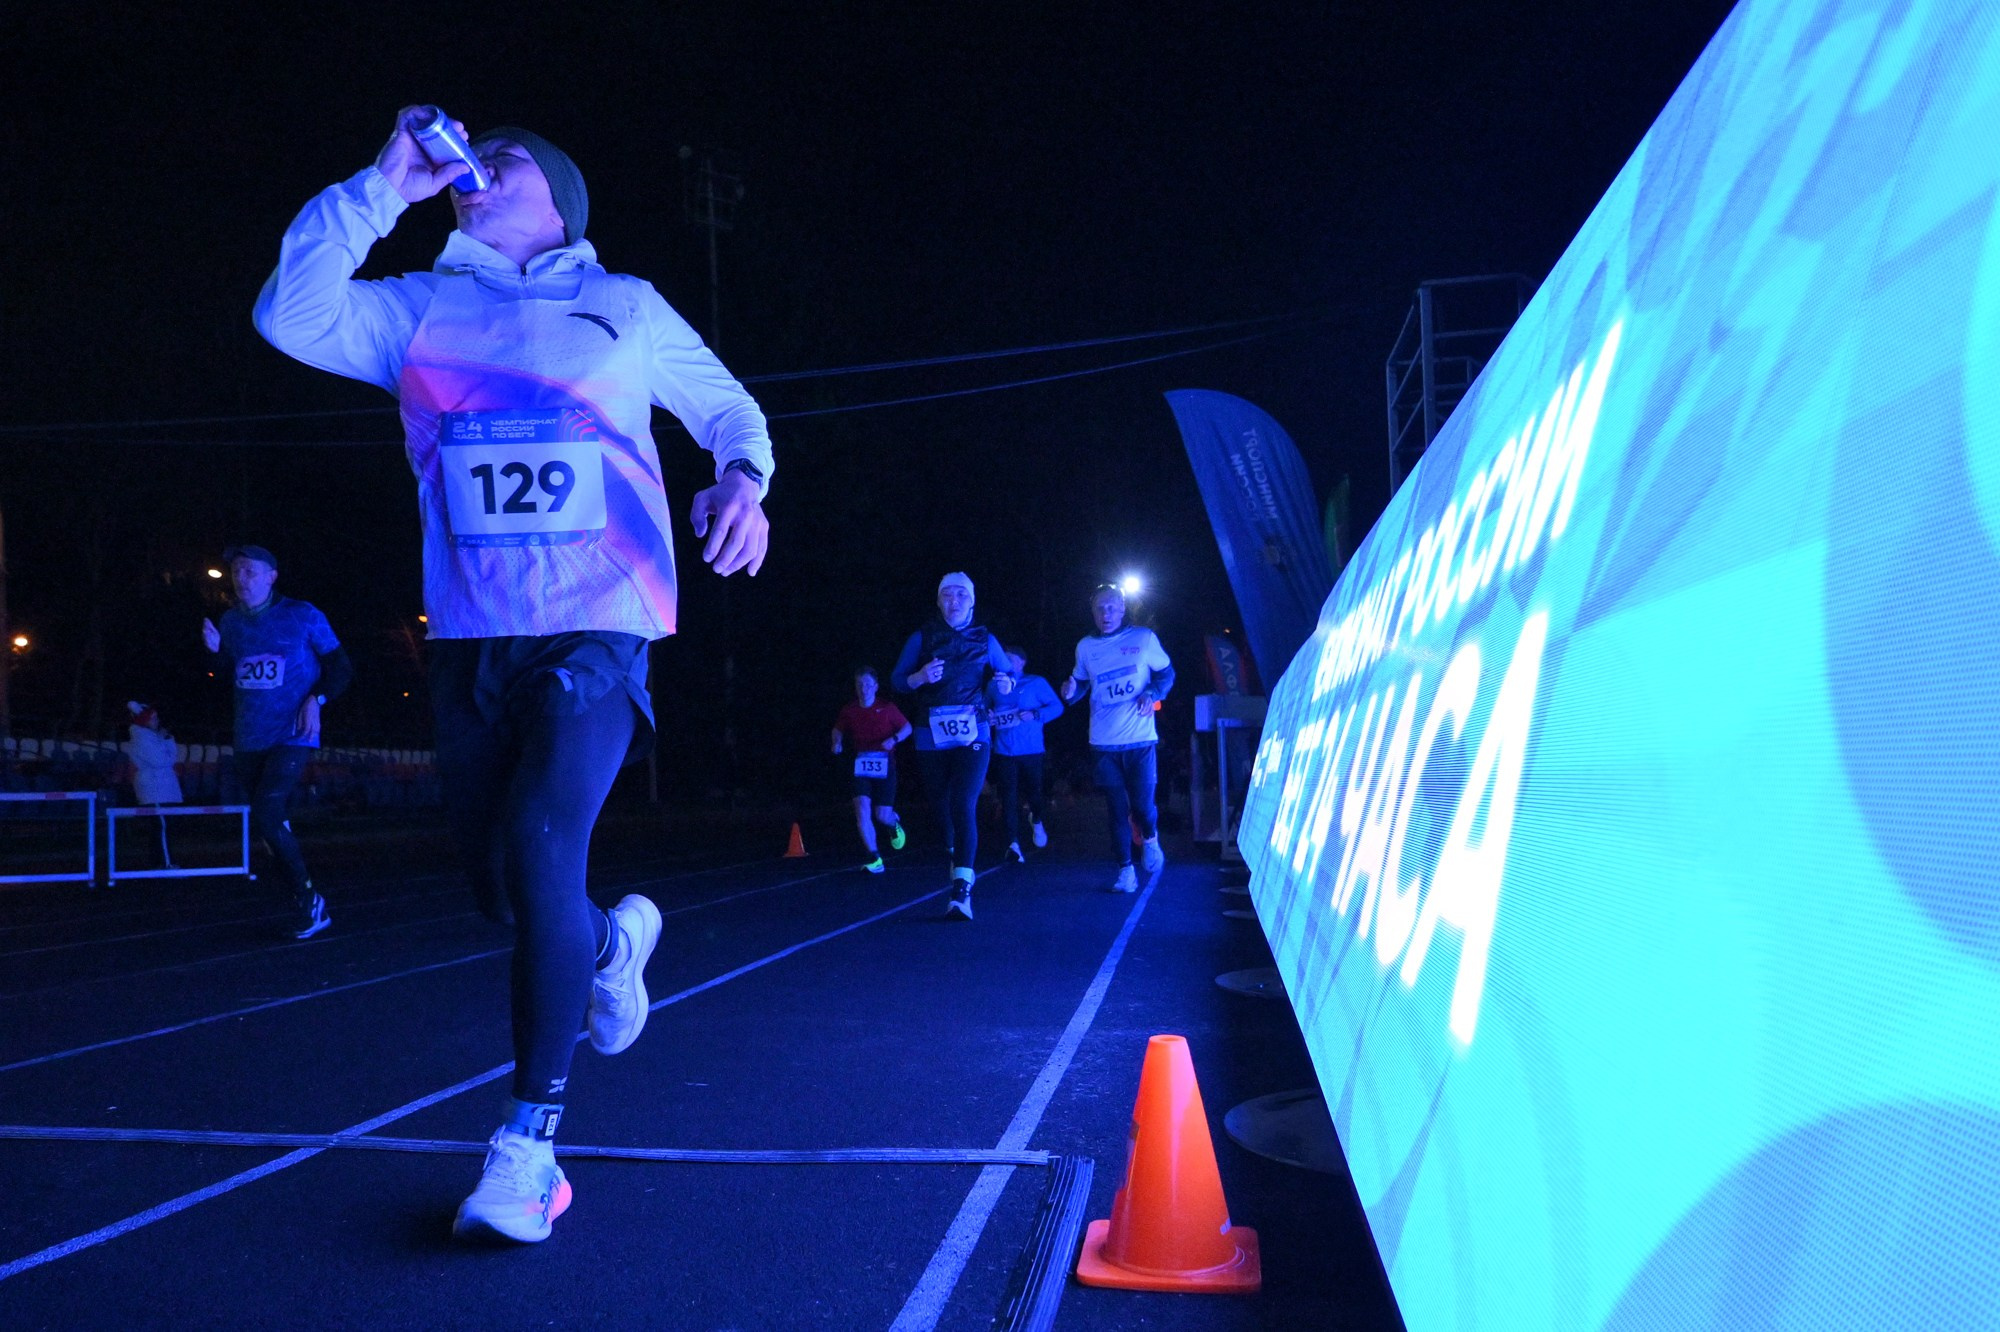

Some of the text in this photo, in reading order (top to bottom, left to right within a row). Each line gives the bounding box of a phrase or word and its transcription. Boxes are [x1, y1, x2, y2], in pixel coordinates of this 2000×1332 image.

[452, 421, 483, 433] 24
[490, 418, 558, 426] ЧЕМПИОНАТ
[508, 431, 535, 439] БЕГУ
[469, 460, 576, 514] 129
[240, 660, 277, 680] 203
[1106, 680, 1135, 699] 146
[995, 713, 1015, 726] 139
[938, 719, 970, 736] 183
[861, 760, 882, 772] 133
[1331, 611, 1549, 1045] ЧАСА
